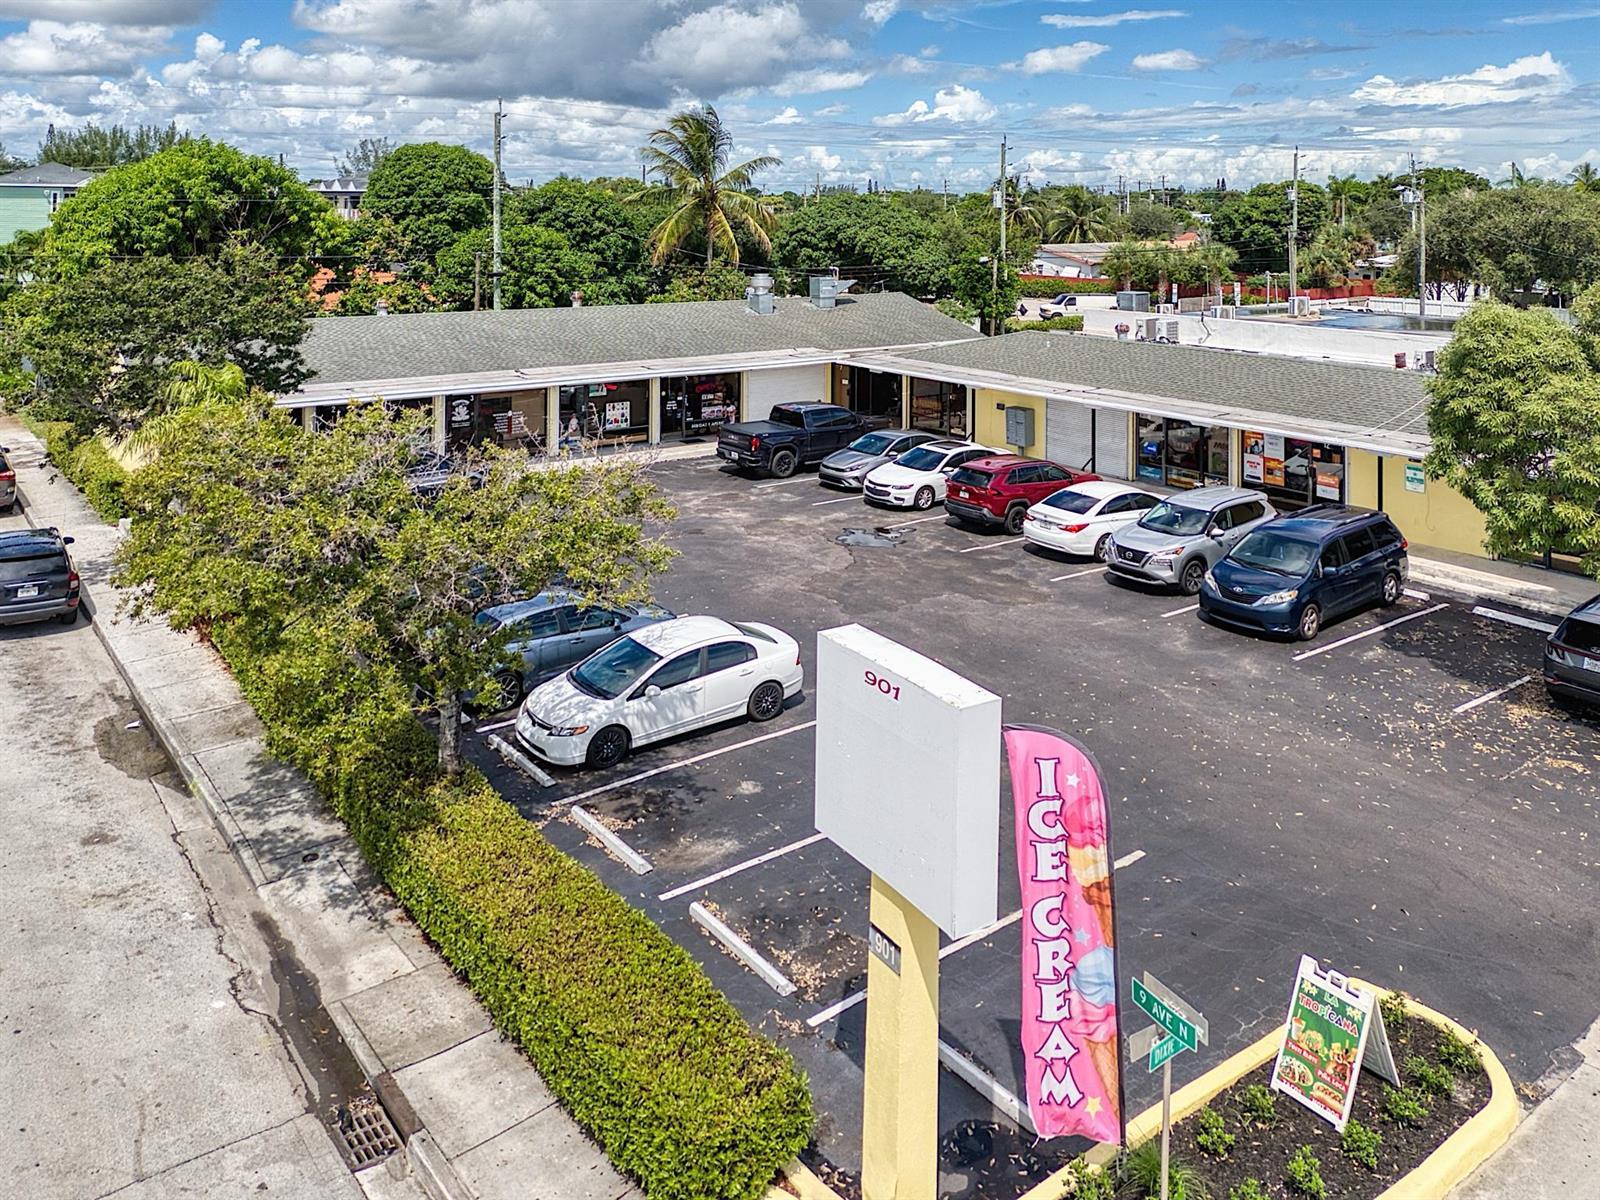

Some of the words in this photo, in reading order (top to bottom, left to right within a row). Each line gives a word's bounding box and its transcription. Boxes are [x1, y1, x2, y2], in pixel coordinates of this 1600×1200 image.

[864, 670, 900, 701] 901
[1027, 757, 1071, 884] ICE
[875, 932, 895, 965] 901
[1031, 891, 1084, 1108] CREAM
[1139, 989, 1147, 1004] 9
[1152, 1002, 1173, 1030] AVE
[1179, 1022, 1188, 1041] N
[1324, 991, 1339, 1008] LA
[1154, 1038, 1175, 1065] DIXIE
